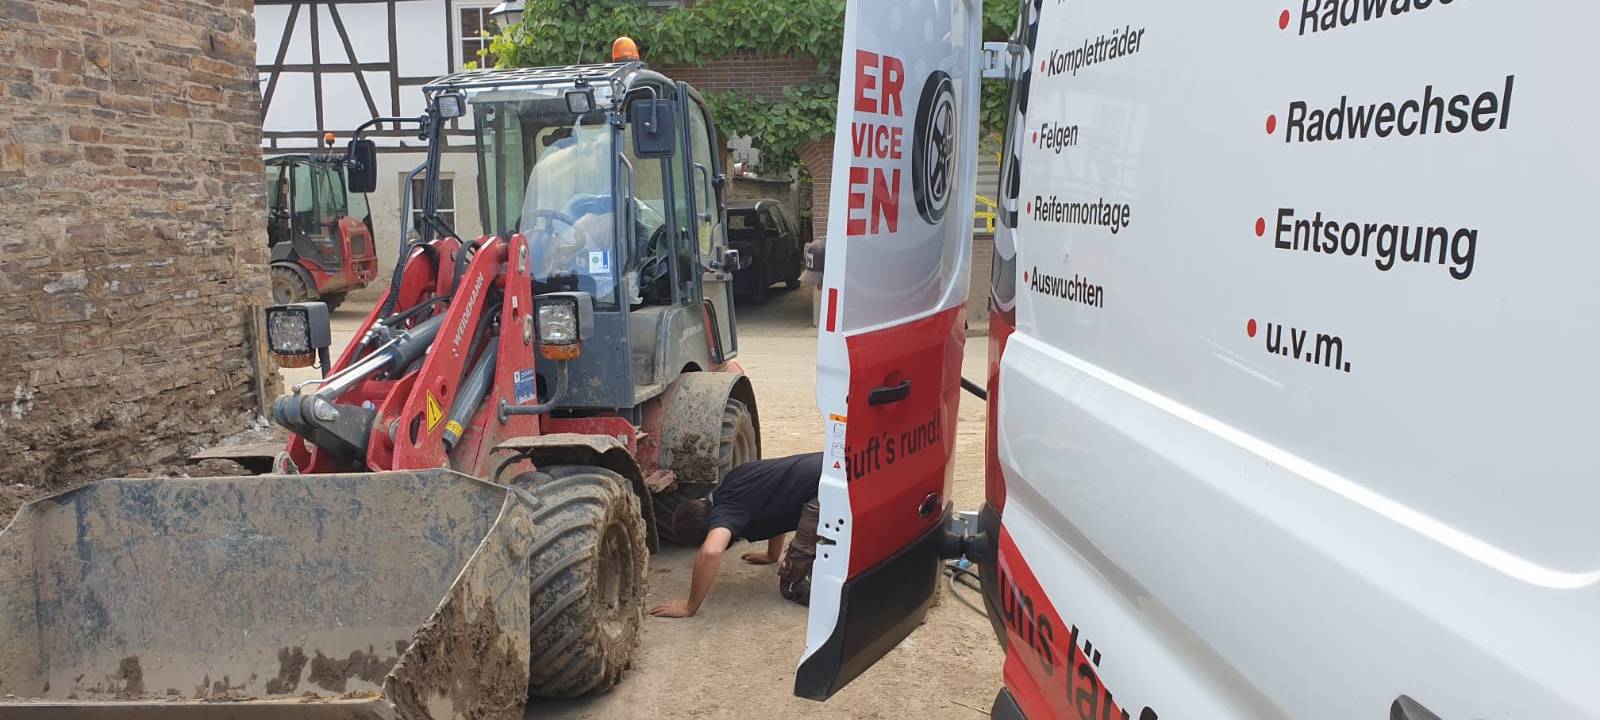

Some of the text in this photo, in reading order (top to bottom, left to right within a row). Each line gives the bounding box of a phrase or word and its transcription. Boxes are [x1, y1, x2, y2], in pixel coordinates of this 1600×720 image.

[1048, 25, 1145, 77] Kompletträder
[854, 49, 905, 117] ER
[1285, 75, 1515, 143] Radwechsel
[851, 122, 903, 160] VICE
[1039, 123, 1078, 155] Felgen
[846, 166, 901, 236] EN
[1034, 196, 1130, 235] Reifenmontage
[1274, 207, 1479, 281] Entsorgung
[453, 271, 485, 347] WEIDEMANN
[1031, 266, 1104, 308] Auswuchten
[1265, 322, 1352, 373] u.v.m.
[900, 406, 940, 458] rund!
[1000, 567, 1054, 676] uns
